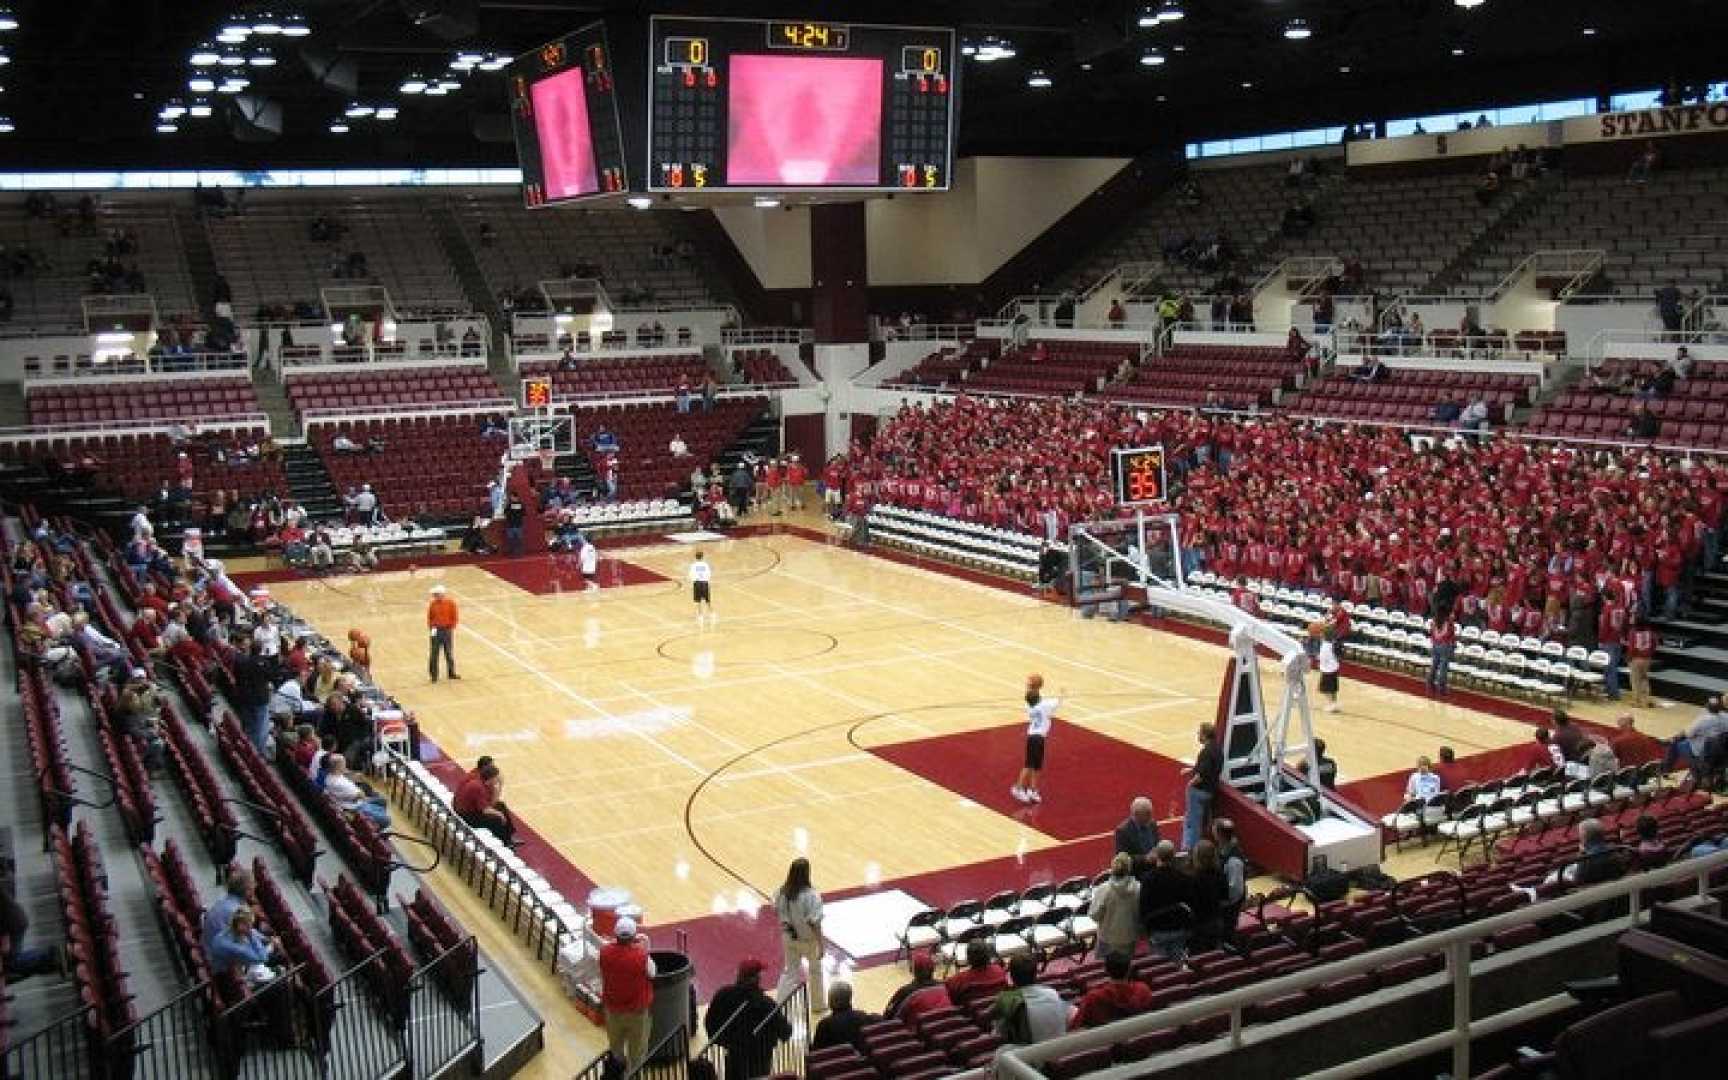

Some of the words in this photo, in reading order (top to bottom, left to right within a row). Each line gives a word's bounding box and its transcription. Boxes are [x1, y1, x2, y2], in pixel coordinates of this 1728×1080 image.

[784, 24, 829, 48] 4:24
[690, 39, 704, 65] 0
[922, 49, 935, 72] 0
[694, 168, 705, 190] 5
[925, 169, 936, 190] 5
[1130, 472, 1156, 499] 35
